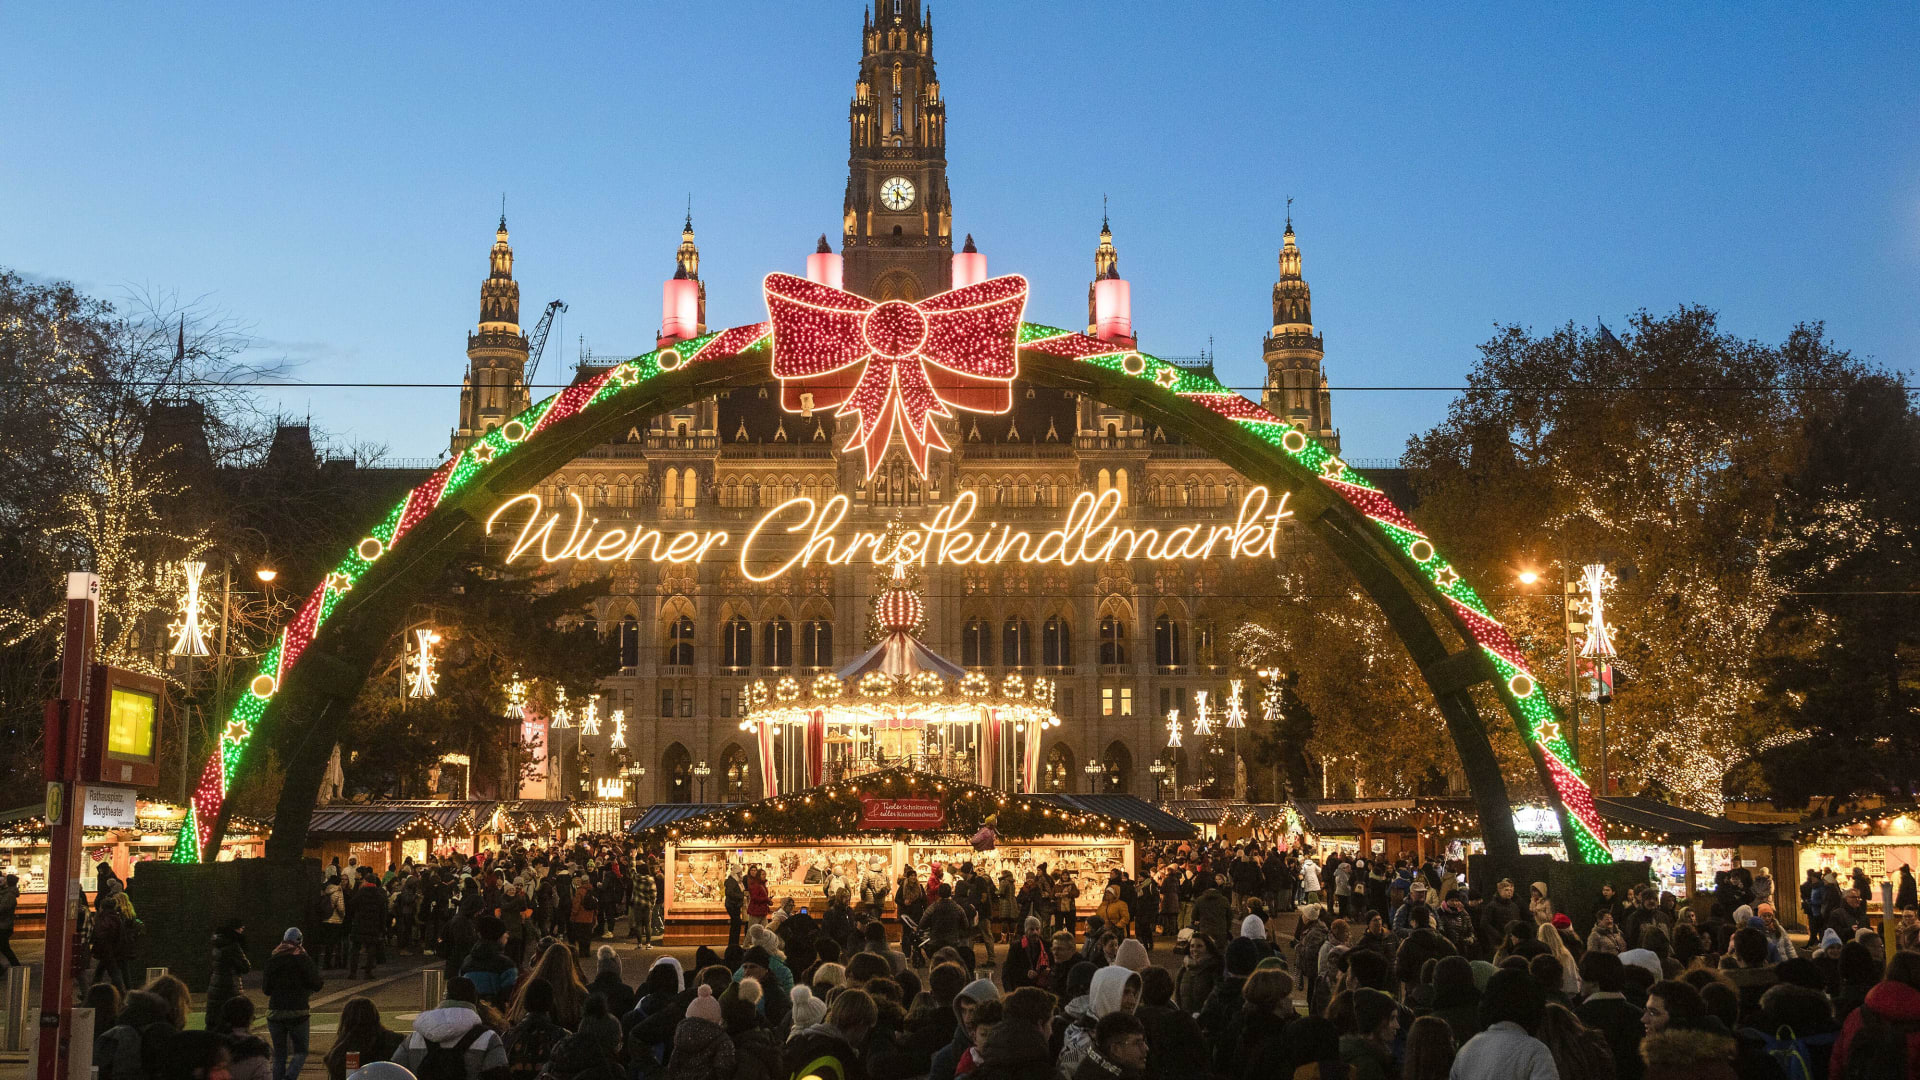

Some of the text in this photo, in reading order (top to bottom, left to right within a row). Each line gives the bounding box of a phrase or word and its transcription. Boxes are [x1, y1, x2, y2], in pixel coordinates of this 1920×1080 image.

[486, 485, 1294, 582] Wiener Christkindlmarkt
[81, 646, 93, 759] WIENER LINIEN
[92, 804, 124, 818] Burgtheater
[902, 803, 938, 811] Schnitzereien
